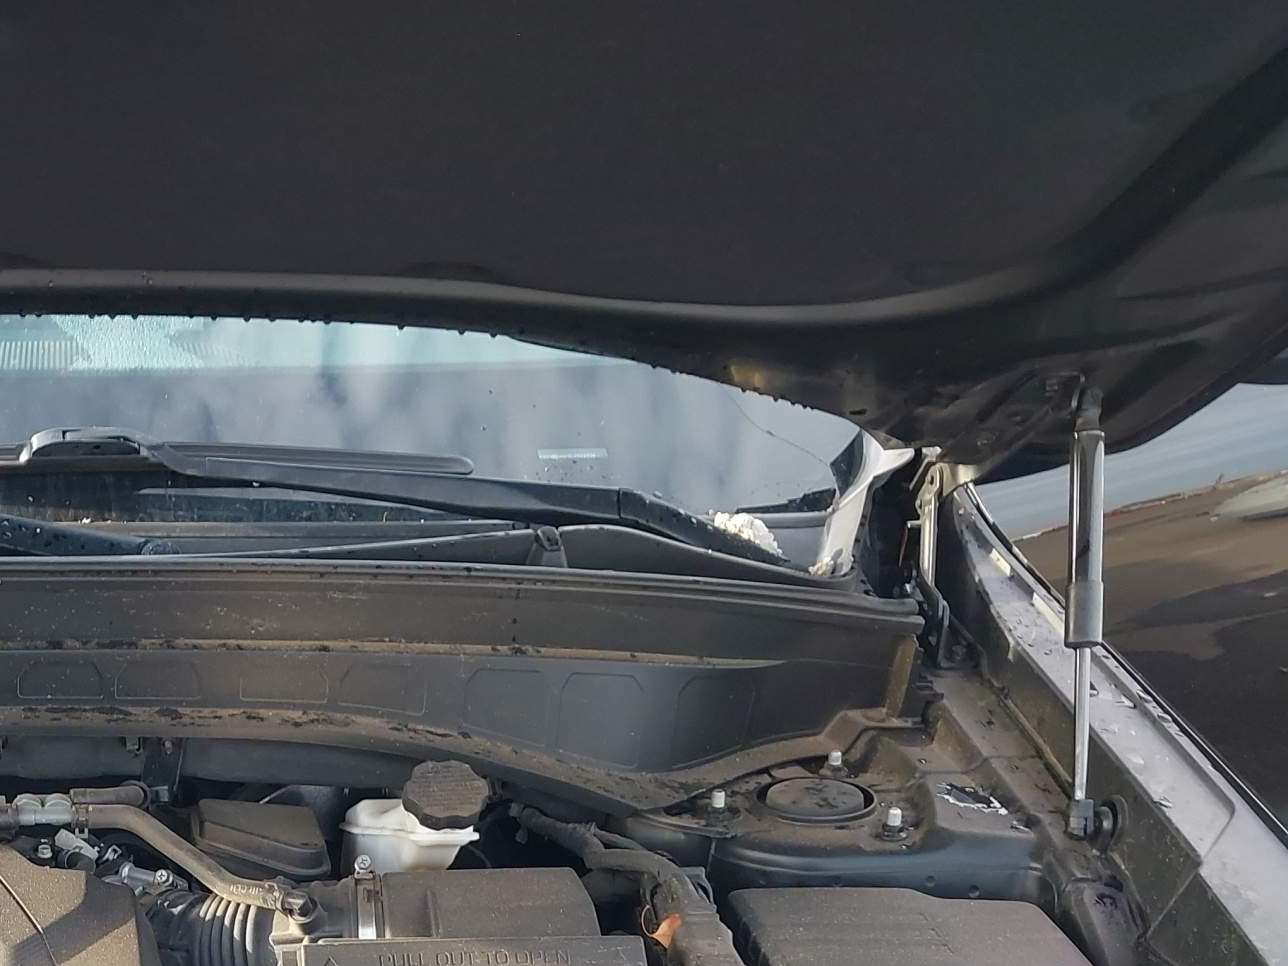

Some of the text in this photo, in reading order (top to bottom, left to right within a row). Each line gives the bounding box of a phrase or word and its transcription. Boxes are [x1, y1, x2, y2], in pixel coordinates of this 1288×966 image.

[435, 951, 474, 966] OUT
[484, 950, 509, 966] TO
[515, 950, 571, 966] OPEN
